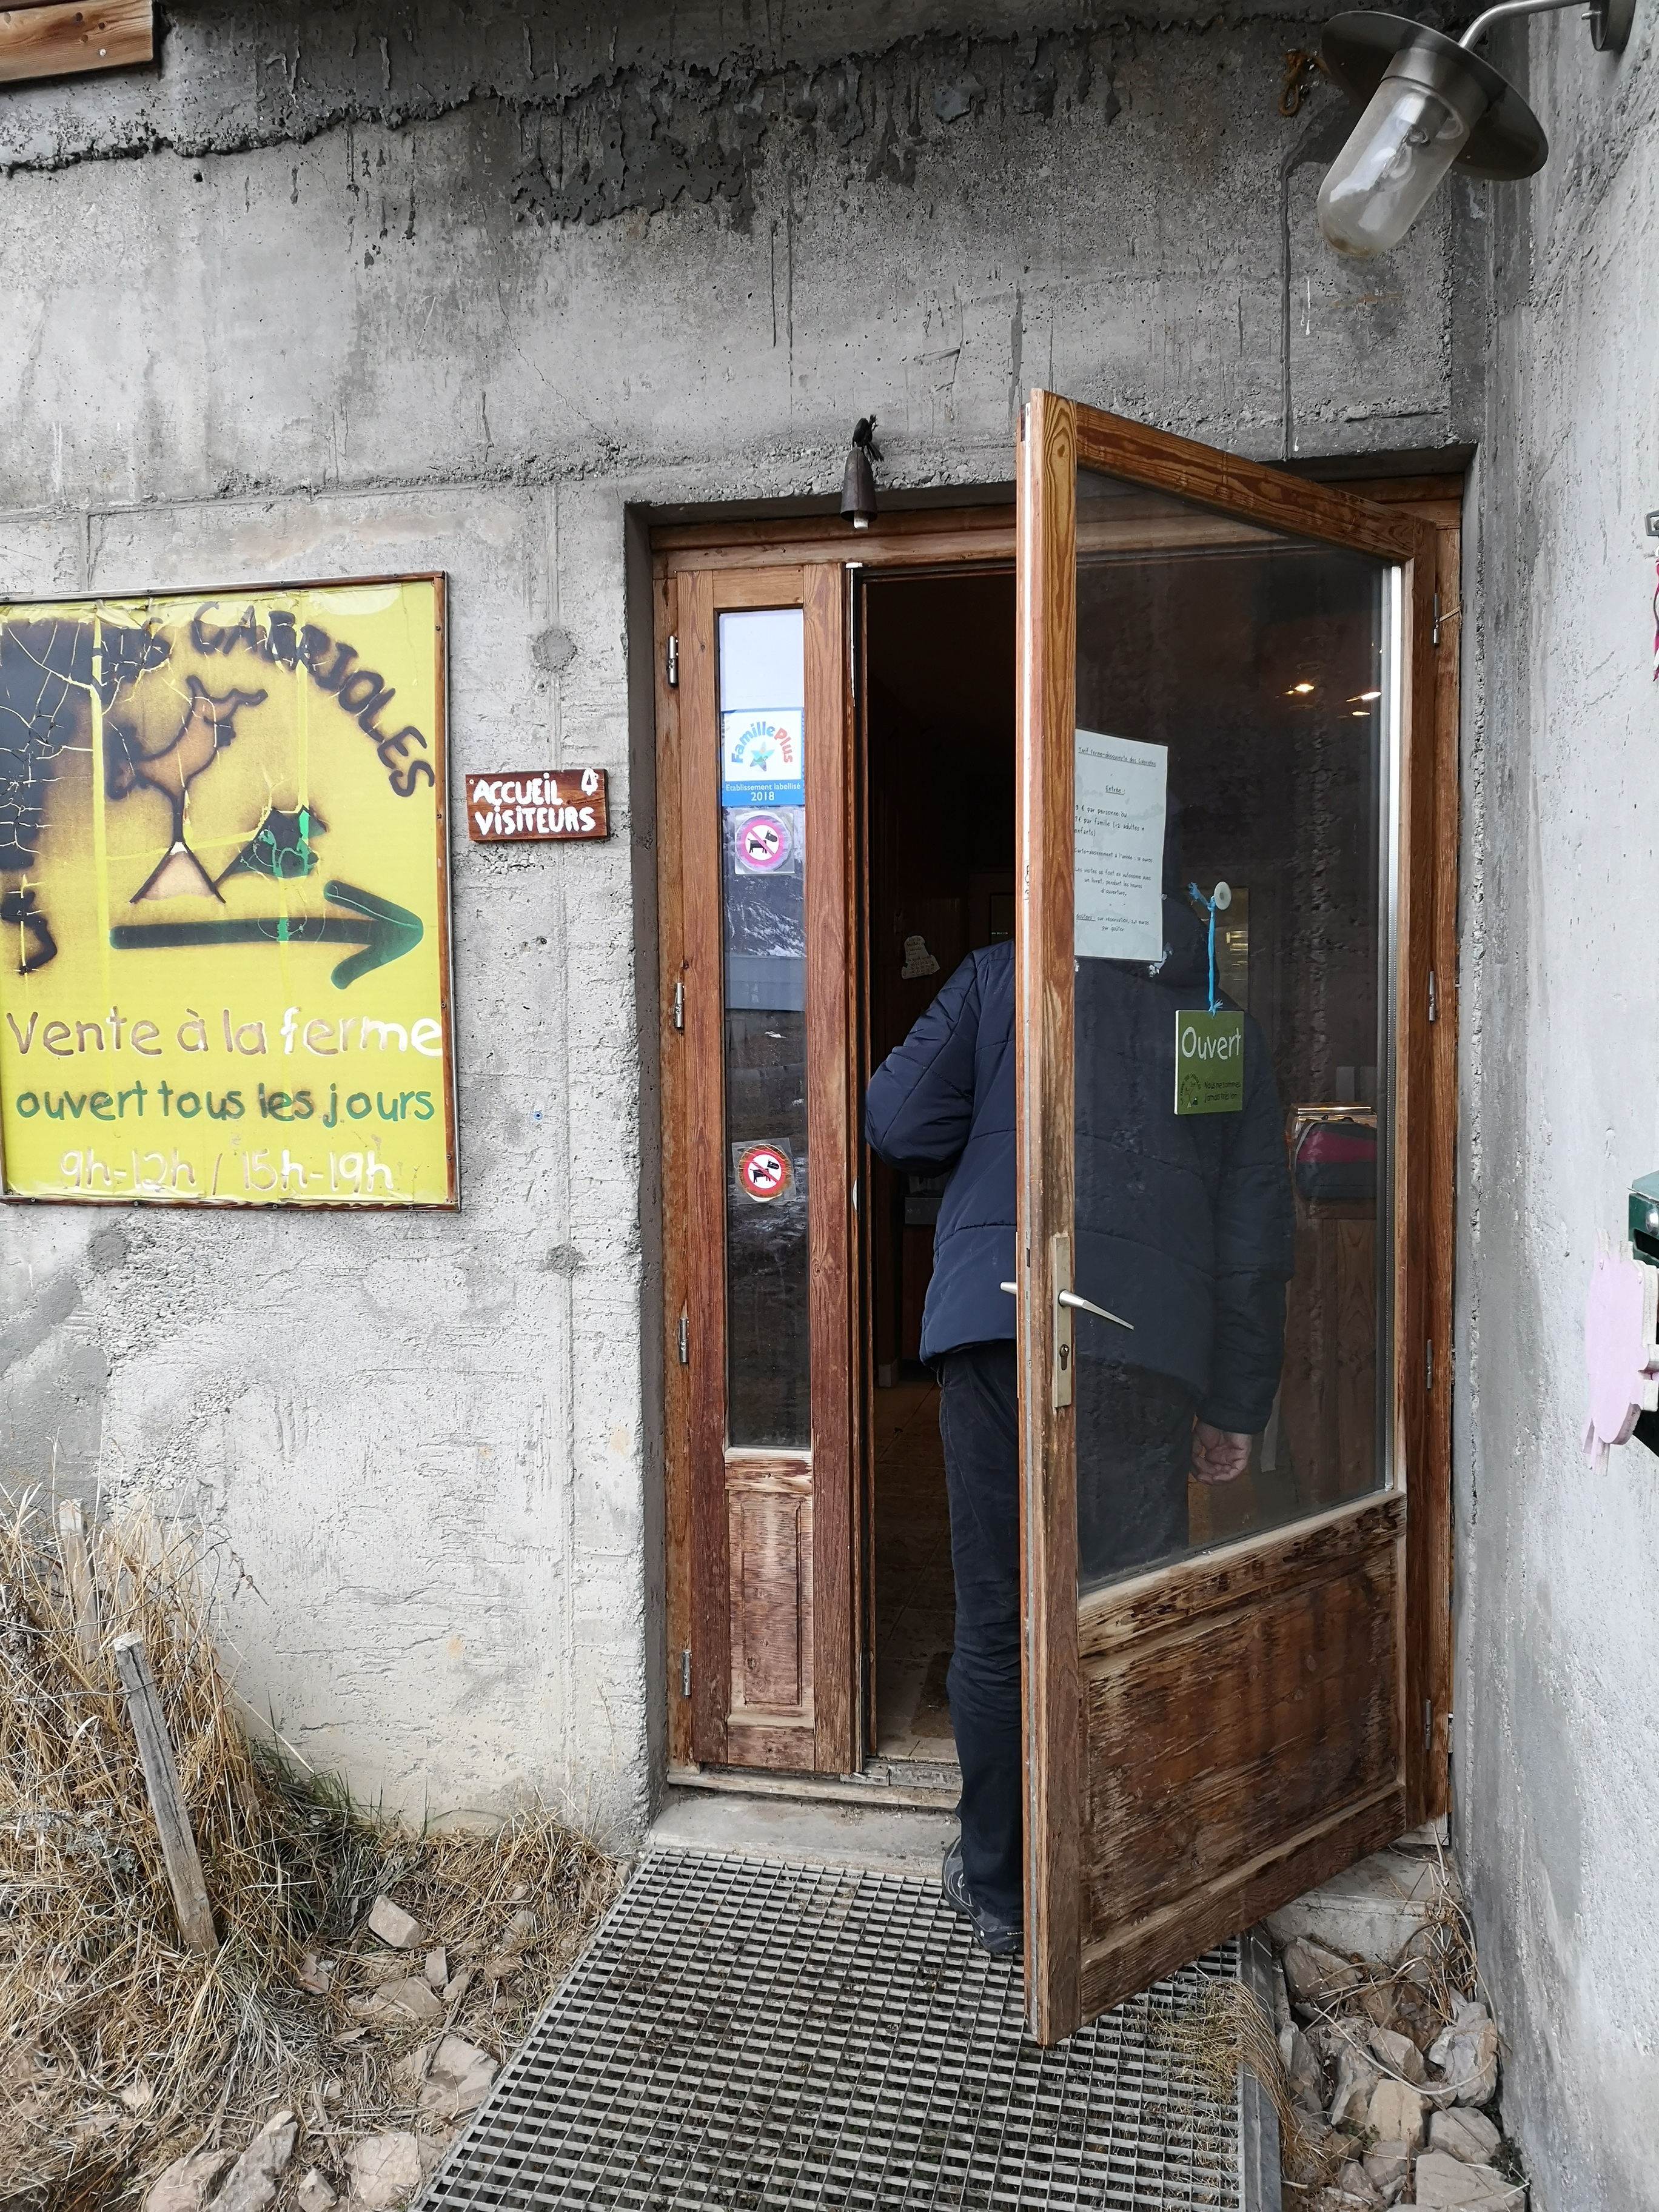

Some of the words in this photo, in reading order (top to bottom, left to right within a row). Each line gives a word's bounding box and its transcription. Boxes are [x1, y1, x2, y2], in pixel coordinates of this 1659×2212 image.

[731, 722, 776, 763] Famille
[774, 727, 793, 763] Plus
[751, 791, 775, 801] 2018
[1094, 817, 1110, 826] famille
[7, 1005, 163, 1056] Vente
[177, 1008, 209, 1053] à
[223, 1009, 269, 1057] la
[281, 1006, 443, 1057] ferme
[1182, 1026, 1242, 1061] Ouvert
[16, 1080, 147, 1120] ouvert
[158, 1080, 243, 1121] tous
[259, 1082, 315, 1121] les
[323, 1083, 435, 1128] jours
[61, 1147, 196, 1190] 9h-12h
[243, 1149, 394, 1193] 15h-19h
